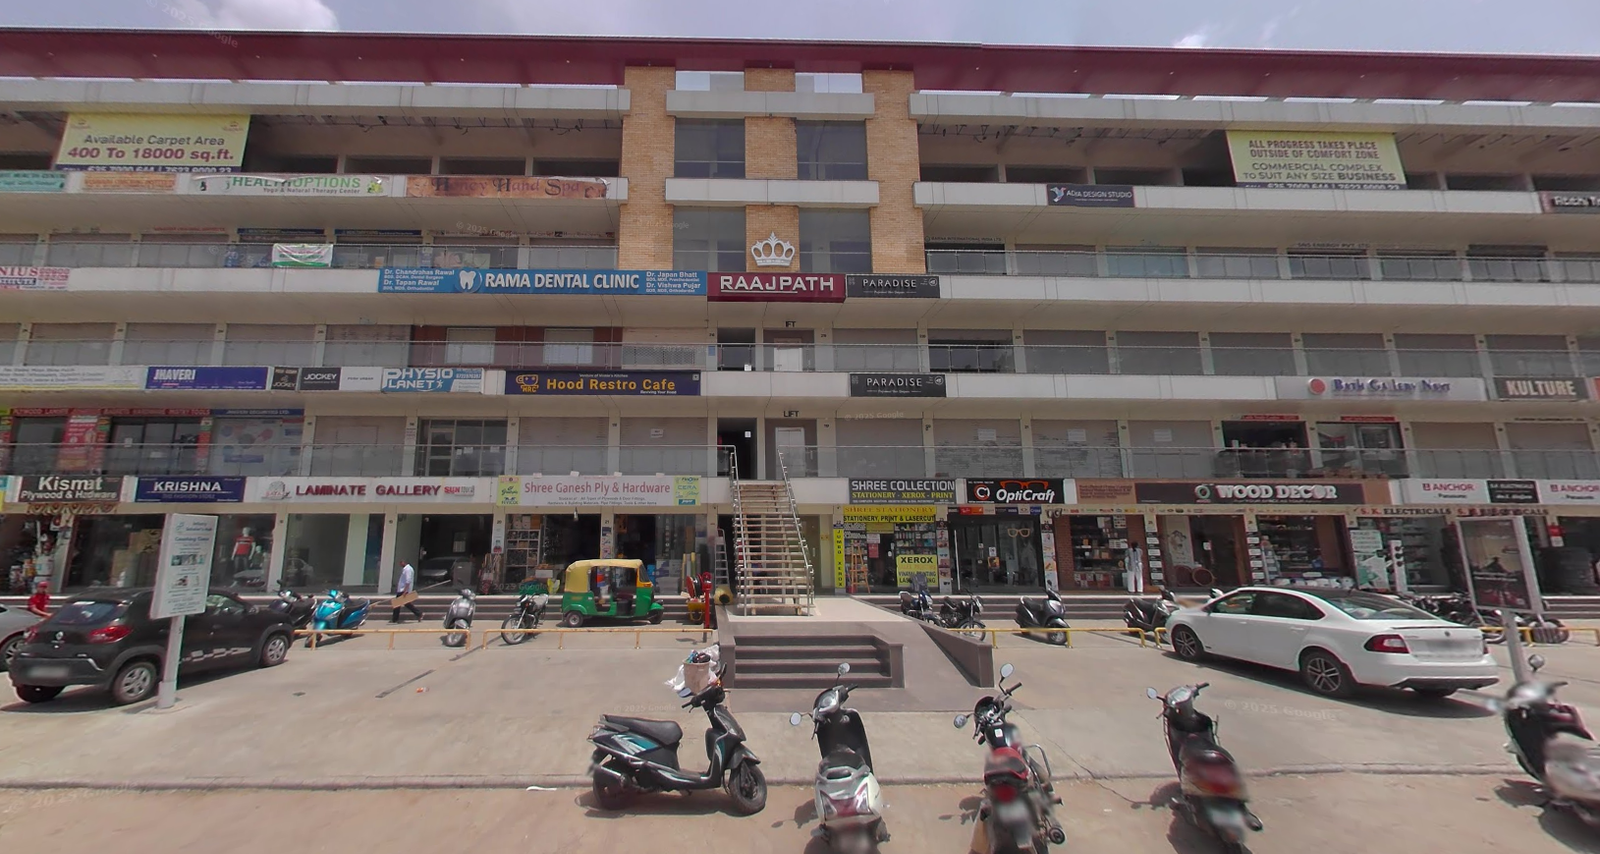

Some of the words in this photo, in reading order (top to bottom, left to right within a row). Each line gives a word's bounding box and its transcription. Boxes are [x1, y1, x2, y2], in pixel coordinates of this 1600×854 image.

[84, 134, 144, 146] Available
[148, 135, 190, 147] Carpet
[193, 136, 225, 146] Area
[1248, 140, 1265, 149] ALL
[1267, 140, 1315, 150] PROGRESS
[1316, 141, 1346, 150] TAKES
[1347, 141, 1377, 150] PLACE
[68, 147, 101, 158] 400
[107, 148, 126, 158] To
[133, 148, 185, 159] 18000
[189, 148, 234, 162] sq.ft.
[1250, 150, 1289, 159] OUTSIDE
[1292, 150, 1304, 159] OF
[1306, 150, 1352, 159] COMFORT
[1355, 151, 1380, 160] ZONE
[1251, 162, 1327, 172] COMMERCIAL
[1330, 163, 1382, 172] COMPLEX
[1258, 171, 1284, 181] SUIT
[1285, 172, 1308, 181] ANY
[1311, 172, 1335, 181] SIZE
[1337, 172, 1396, 182] BUSINESS
[492, 177, 540, 193] Hand
[544, 178, 580, 197] Spa
[657, 271, 678, 279] Japan
[395, 280, 415, 288] Tapan
[485, 273, 531, 288] RAMA
[534, 273, 590, 289] DENTAL
[593, 274, 640, 289] CLINIC
[682, 282, 701, 290] Pujar
[720, 275, 833, 291] RAAJPATH
[862, 279, 917, 288] PARADISE
[153, 369, 197, 380] JHAVERI
[382, 368, 454, 383] PHYSIO
[546, 378, 584, 390] Hood
[589, 378, 637, 390] Restro
[642, 378, 675, 390] Cafe
[866, 377, 923, 387] PARADISE
[1505, 380, 1577, 396] KULTURE
[38, 475, 103, 490] Kismat
[153, 481, 222, 491] KRISHNA
[851, 480, 888, 491] SHREE
[890, 480, 955, 491] COLLECTION
[1432, 483, 1475, 491] ANCHOR
[295, 485, 366, 496] LAMINATE
[375, 485, 441, 496] GALLERY
[524, 482, 554, 493] Shree
[555, 482, 592, 493] Ganesh
[595, 482, 609, 496] Ply
[612, 483, 619, 493] &
[623, 482, 670, 493] Hardware
[1215, 484, 1274, 499] WOOD
[1559, 484, 1599, 493] ANCHOR
[20, 490, 64, 501] Plywood
[65, 490, 73, 498] &
[852, 491, 896, 499] STATIONERY
[901, 491, 926, 499] XEROX
[931, 491, 954, 499] PRINT
[996, 488, 1055, 504] OptiCraft
[900, 556, 933, 564] XEROX
